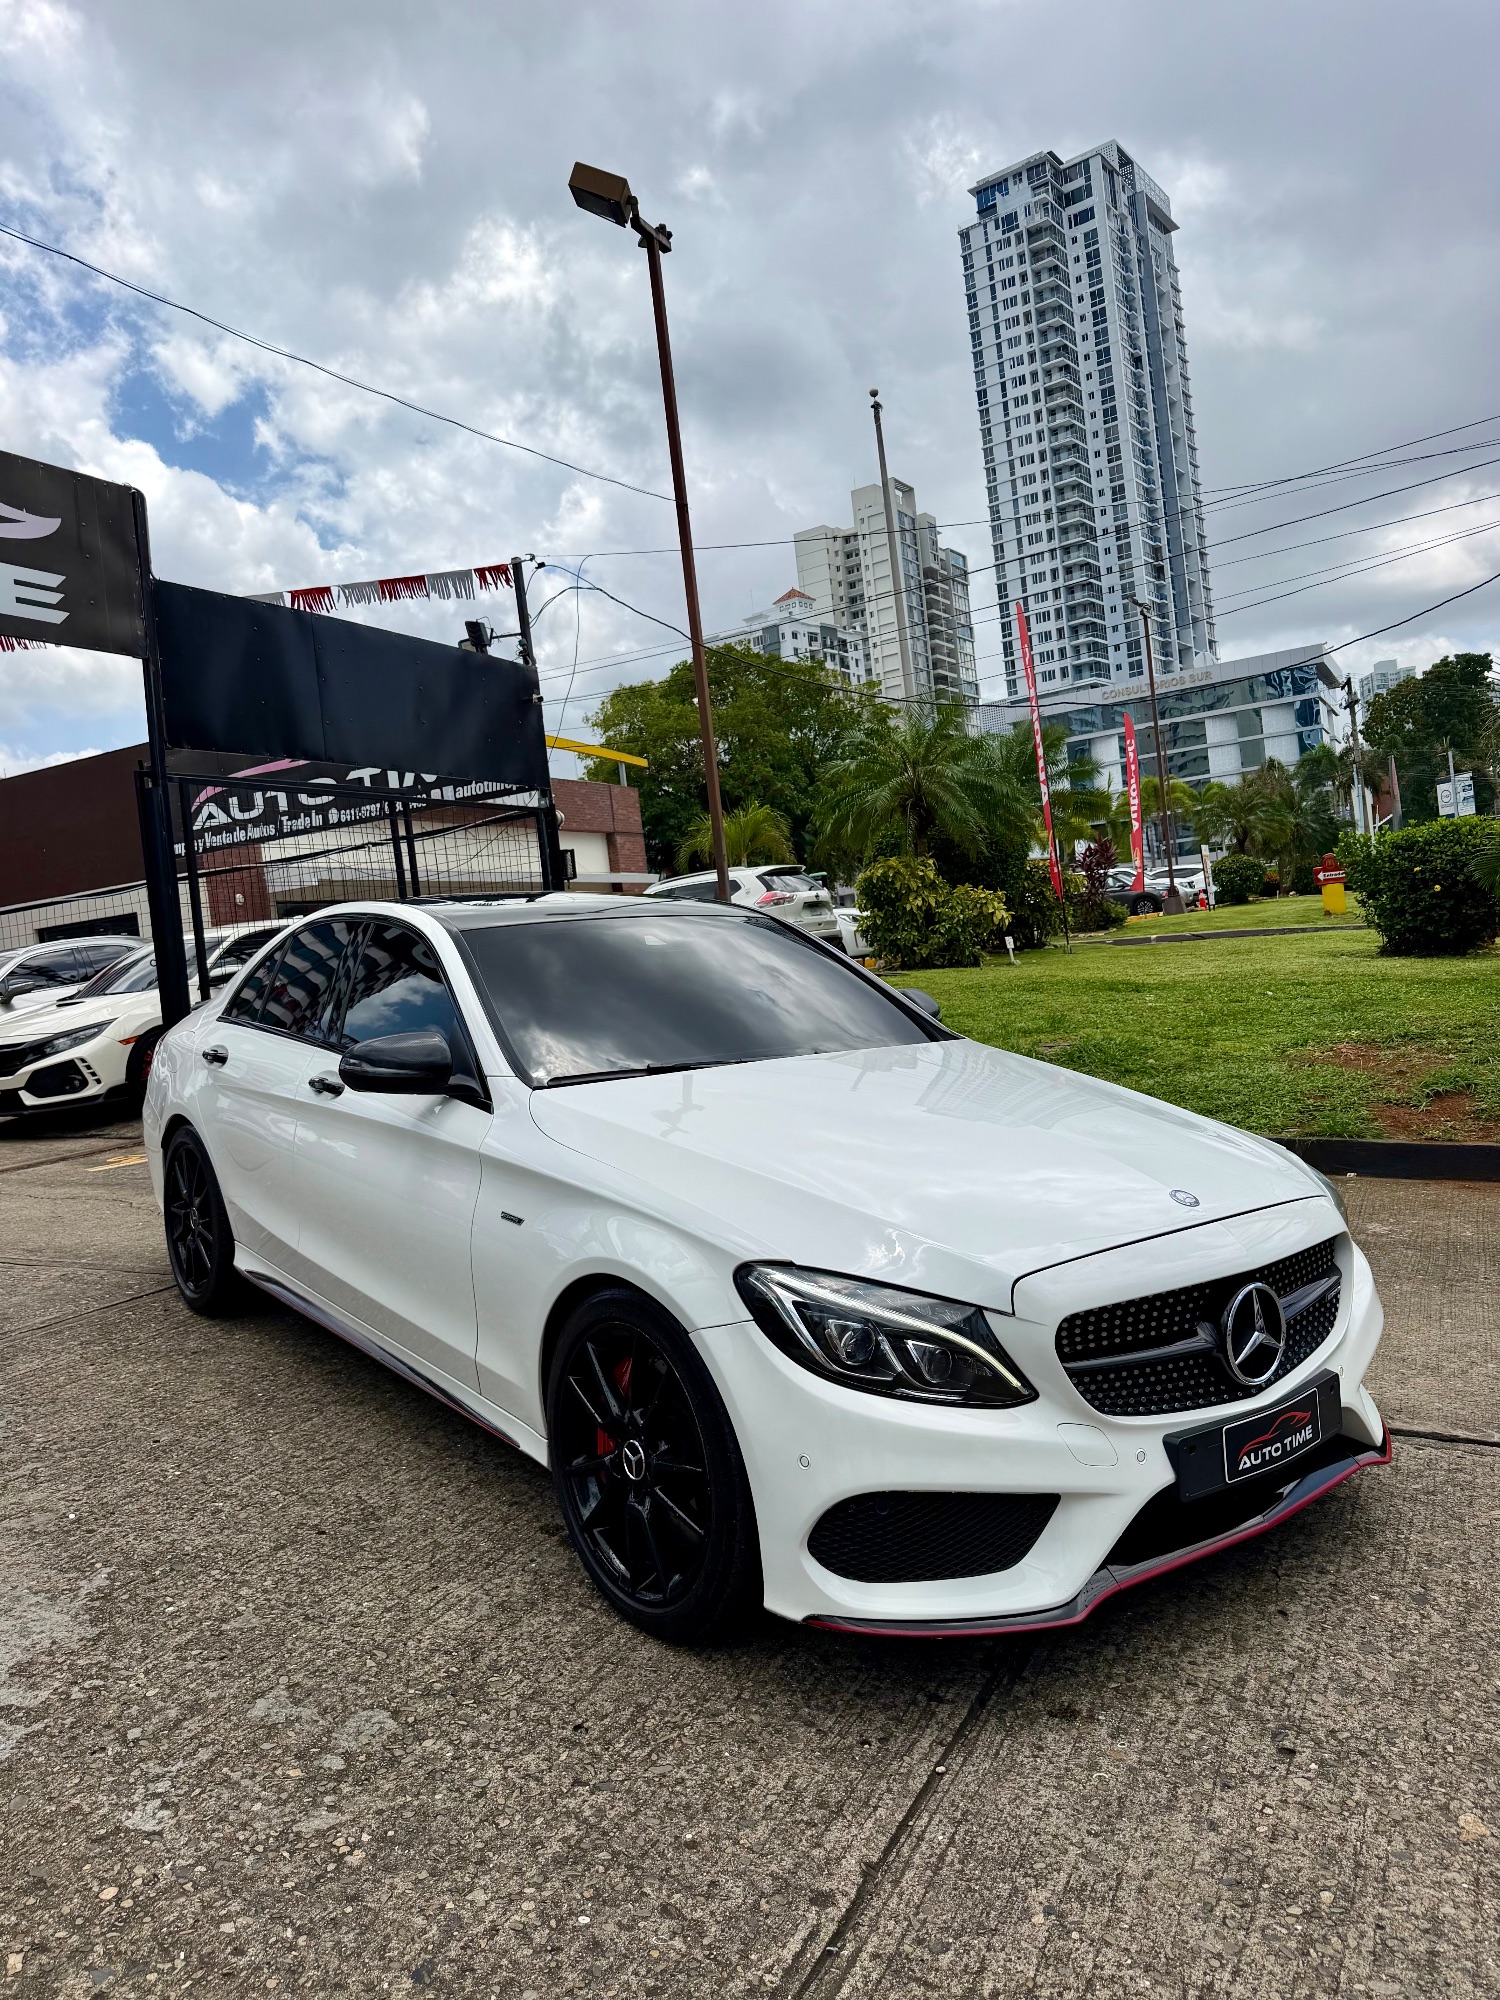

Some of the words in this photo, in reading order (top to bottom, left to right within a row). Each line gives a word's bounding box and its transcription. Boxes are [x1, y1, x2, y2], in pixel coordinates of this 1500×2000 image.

[1102, 675, 1186, 700] CONSULTORIOS
[1188, 671, 1213, 684] SUR
[204, 830, 234, 849] Venta
[233, 827, 247, 843] de
[247, 823, 276, 841] Autos
[281, 815, 311, 833] Trade
[311, 809, 323, 828] In
[1238, 1442, 1282, 1471] AUTO
[1284, 1424, 1313, 1452] TIME
